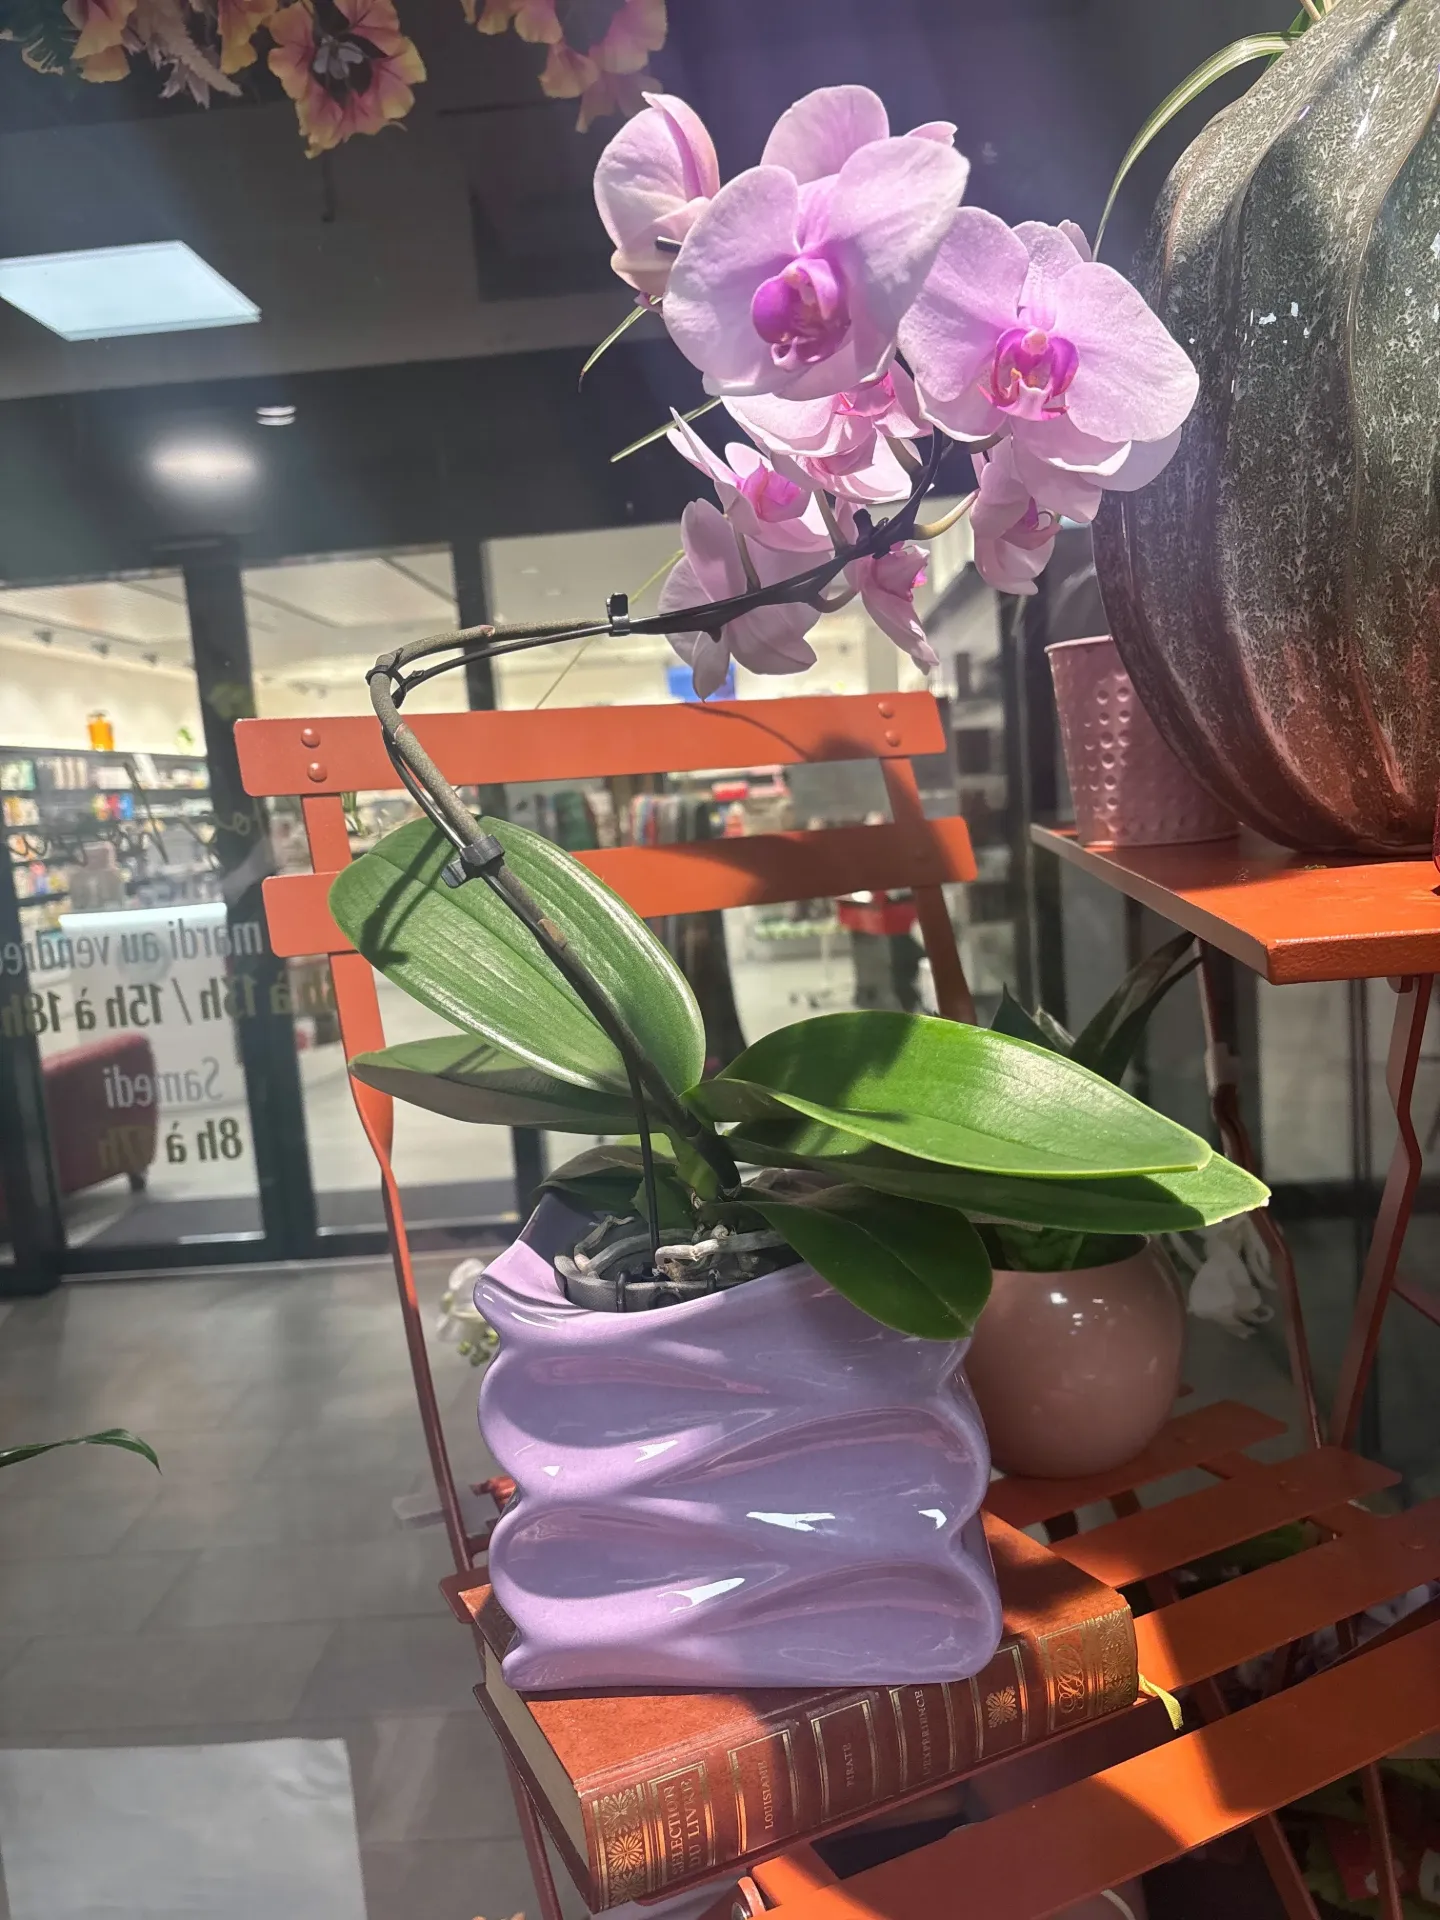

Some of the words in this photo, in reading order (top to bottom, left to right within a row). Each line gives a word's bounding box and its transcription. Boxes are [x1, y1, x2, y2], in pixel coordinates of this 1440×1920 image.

[758, 1760, 774, 1830] LOUISIANE
[843, 1741, 854, 1787] PIRATE
[680, 1778, 700, 1840] LIVRE
